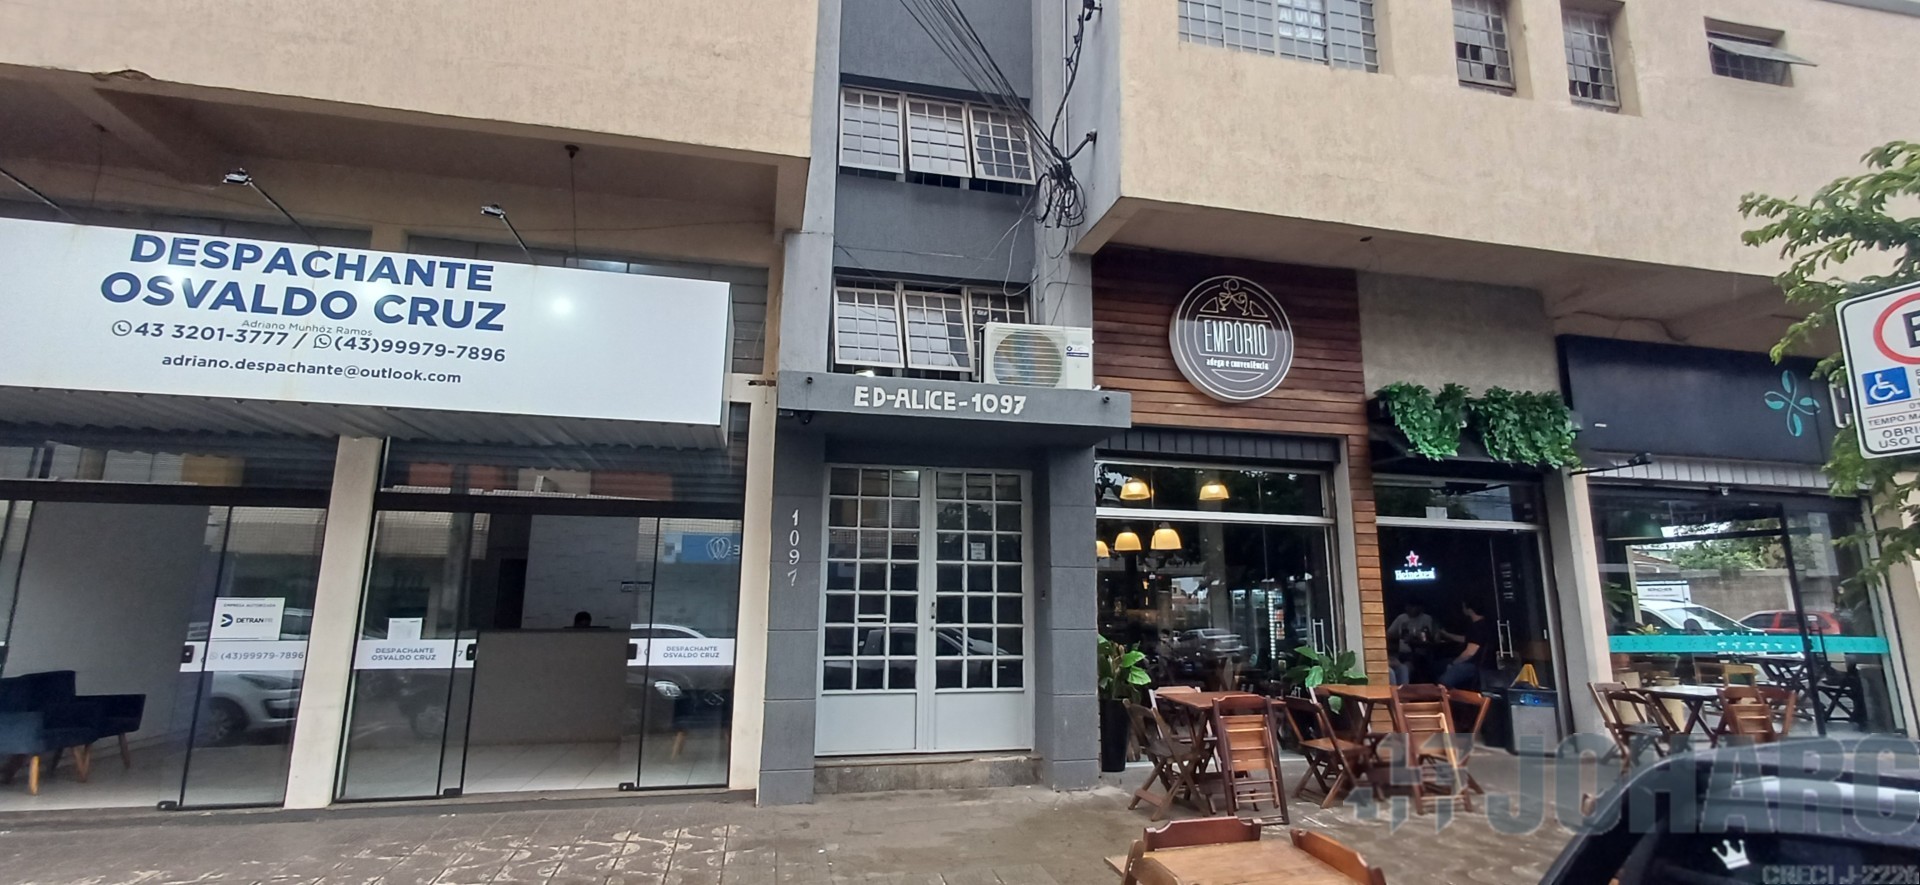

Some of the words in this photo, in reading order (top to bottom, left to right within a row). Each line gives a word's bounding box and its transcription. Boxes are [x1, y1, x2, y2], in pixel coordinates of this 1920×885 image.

[130, 234, 494, 291] DESPACHANTE
[101, 272, 358, 320] OSVALDO
[374, 294, 506, 332] CRUZ
[241, 320, 286, 330] Adriano
[335, 326, 373, 336] Ramos
[134, 322, 165, 337] 43
[171, 324, 289, 346] 3201-3777
[334, 335, 506, 362] (43)99979-7896
[161, 354, 461, 384] adriano.despachante@outlook.com
[1868, 415, 1906, 426] TEMPO
[1878, 437, 1910, 448] USO
[787, 509, 800, 587] 1097
[1394, 567, 1436, 580] Heineken
[220, 651, 305, 660] (43)99979-7896
